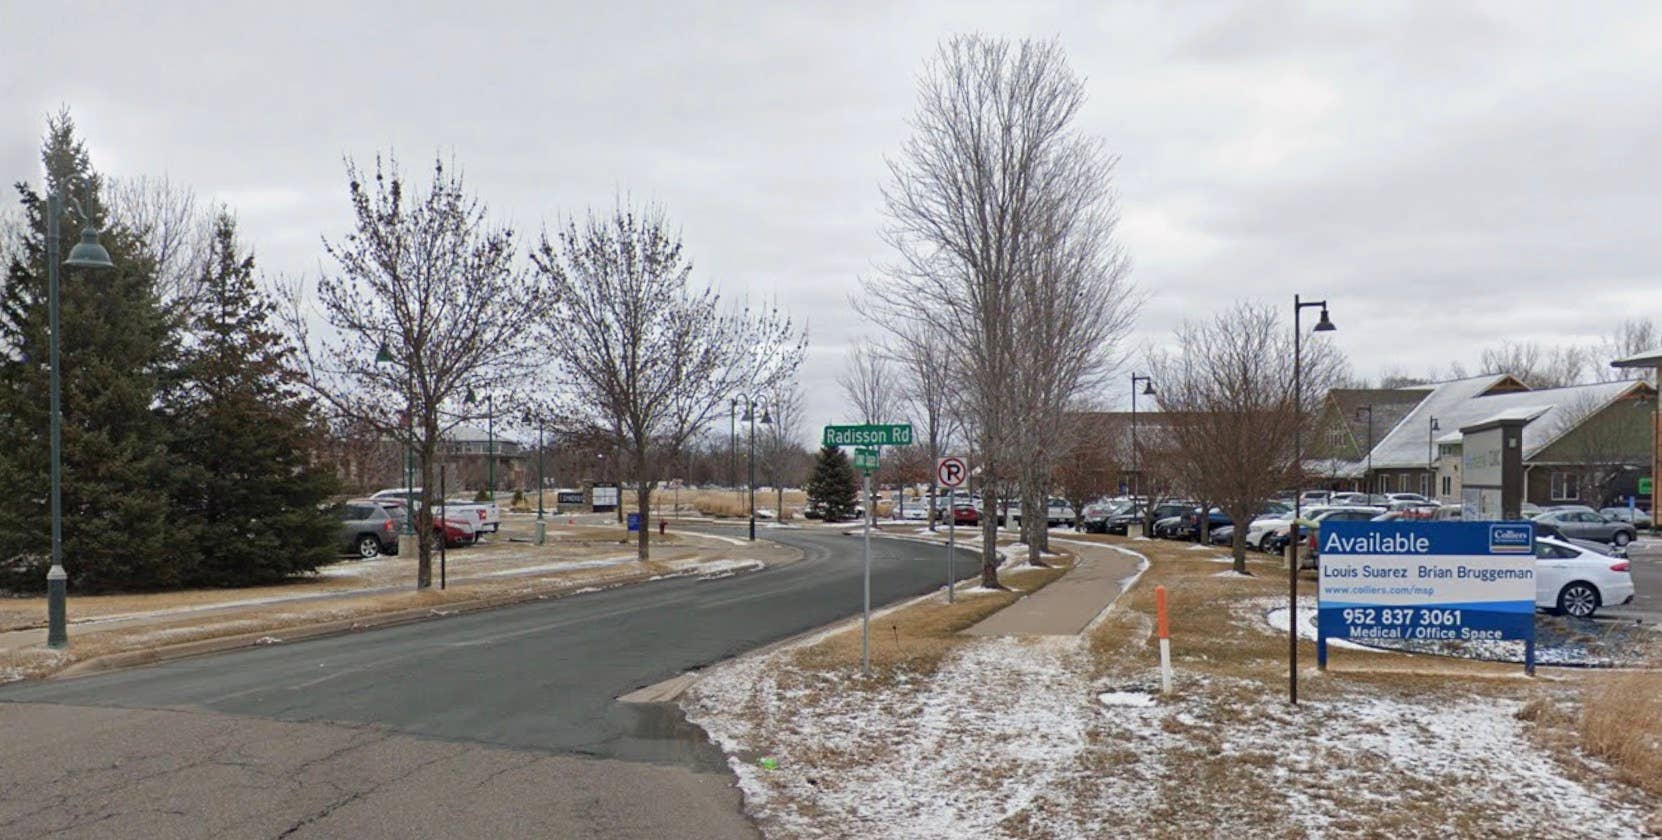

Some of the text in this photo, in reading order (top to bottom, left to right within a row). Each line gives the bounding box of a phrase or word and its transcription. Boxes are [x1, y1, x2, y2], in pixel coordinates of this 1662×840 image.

[827, 427, 909, 443] Radisson Rd
[1324, 532, 1430, 552] Available
[1324, 564, 1533, 581] Louis Suarez Brian Bruggeman
[1343, 609, 1462, 625] 952 837 3061
[1350, 626, 1400, 638] Medical
[1415, 627, 1456, 639] Office
[1461, 627, 1502, 640] Space
